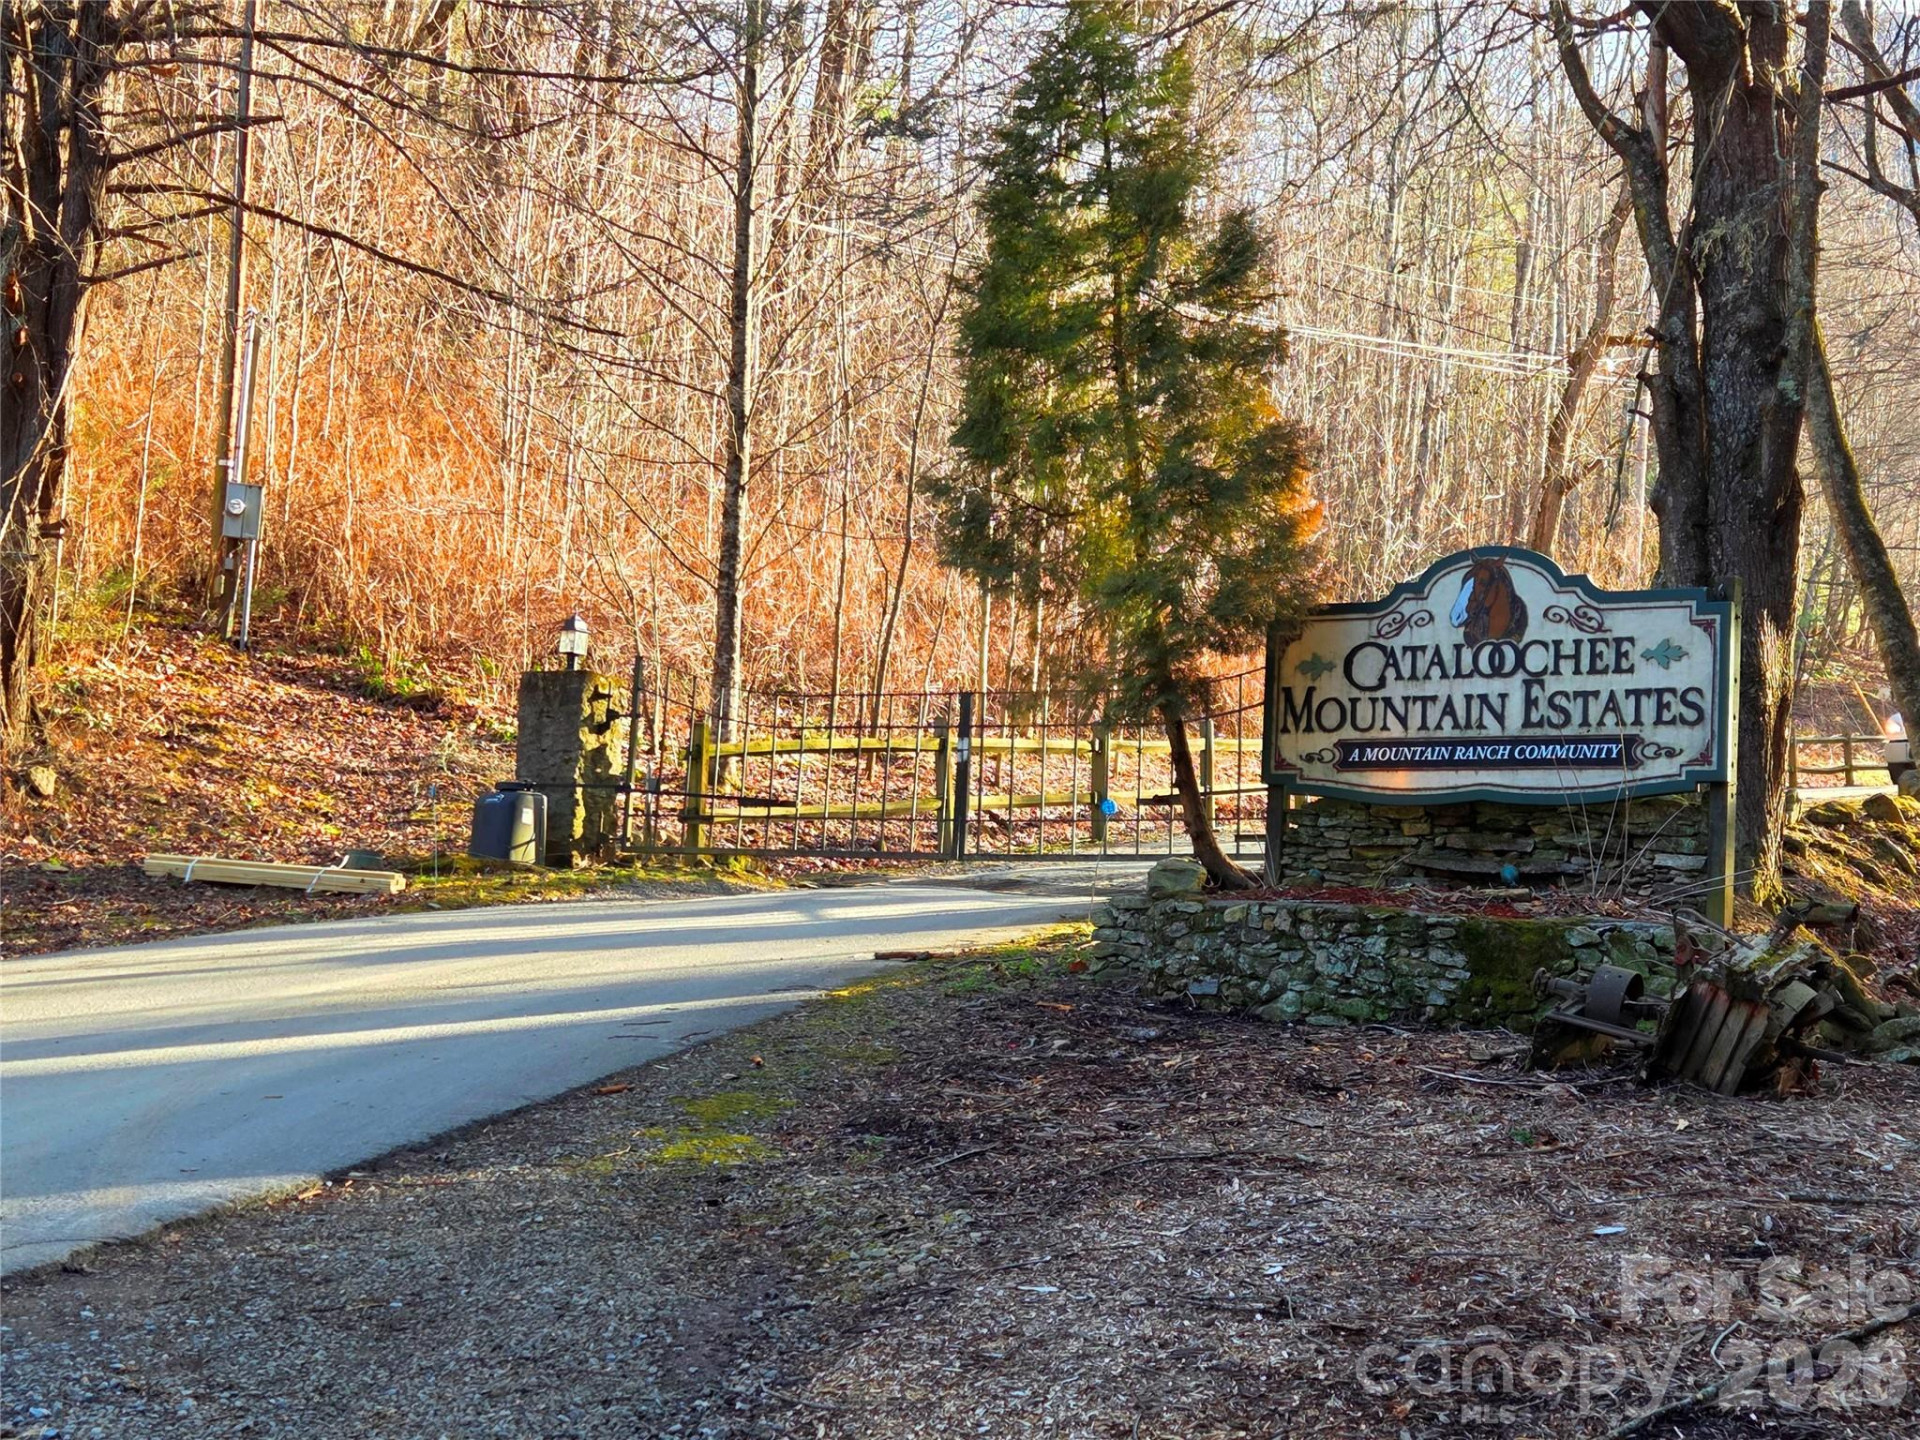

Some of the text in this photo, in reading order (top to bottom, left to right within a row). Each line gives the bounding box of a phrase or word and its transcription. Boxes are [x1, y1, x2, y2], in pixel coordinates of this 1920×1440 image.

[1343, 637, 1636, 692] CATALOOCHEE
[1280, 678, 1705, 735] MOUNTAIN ESTATES
[1348, 743, 1622, 761] A MOUNTAIN RANCH COMMUNITY
